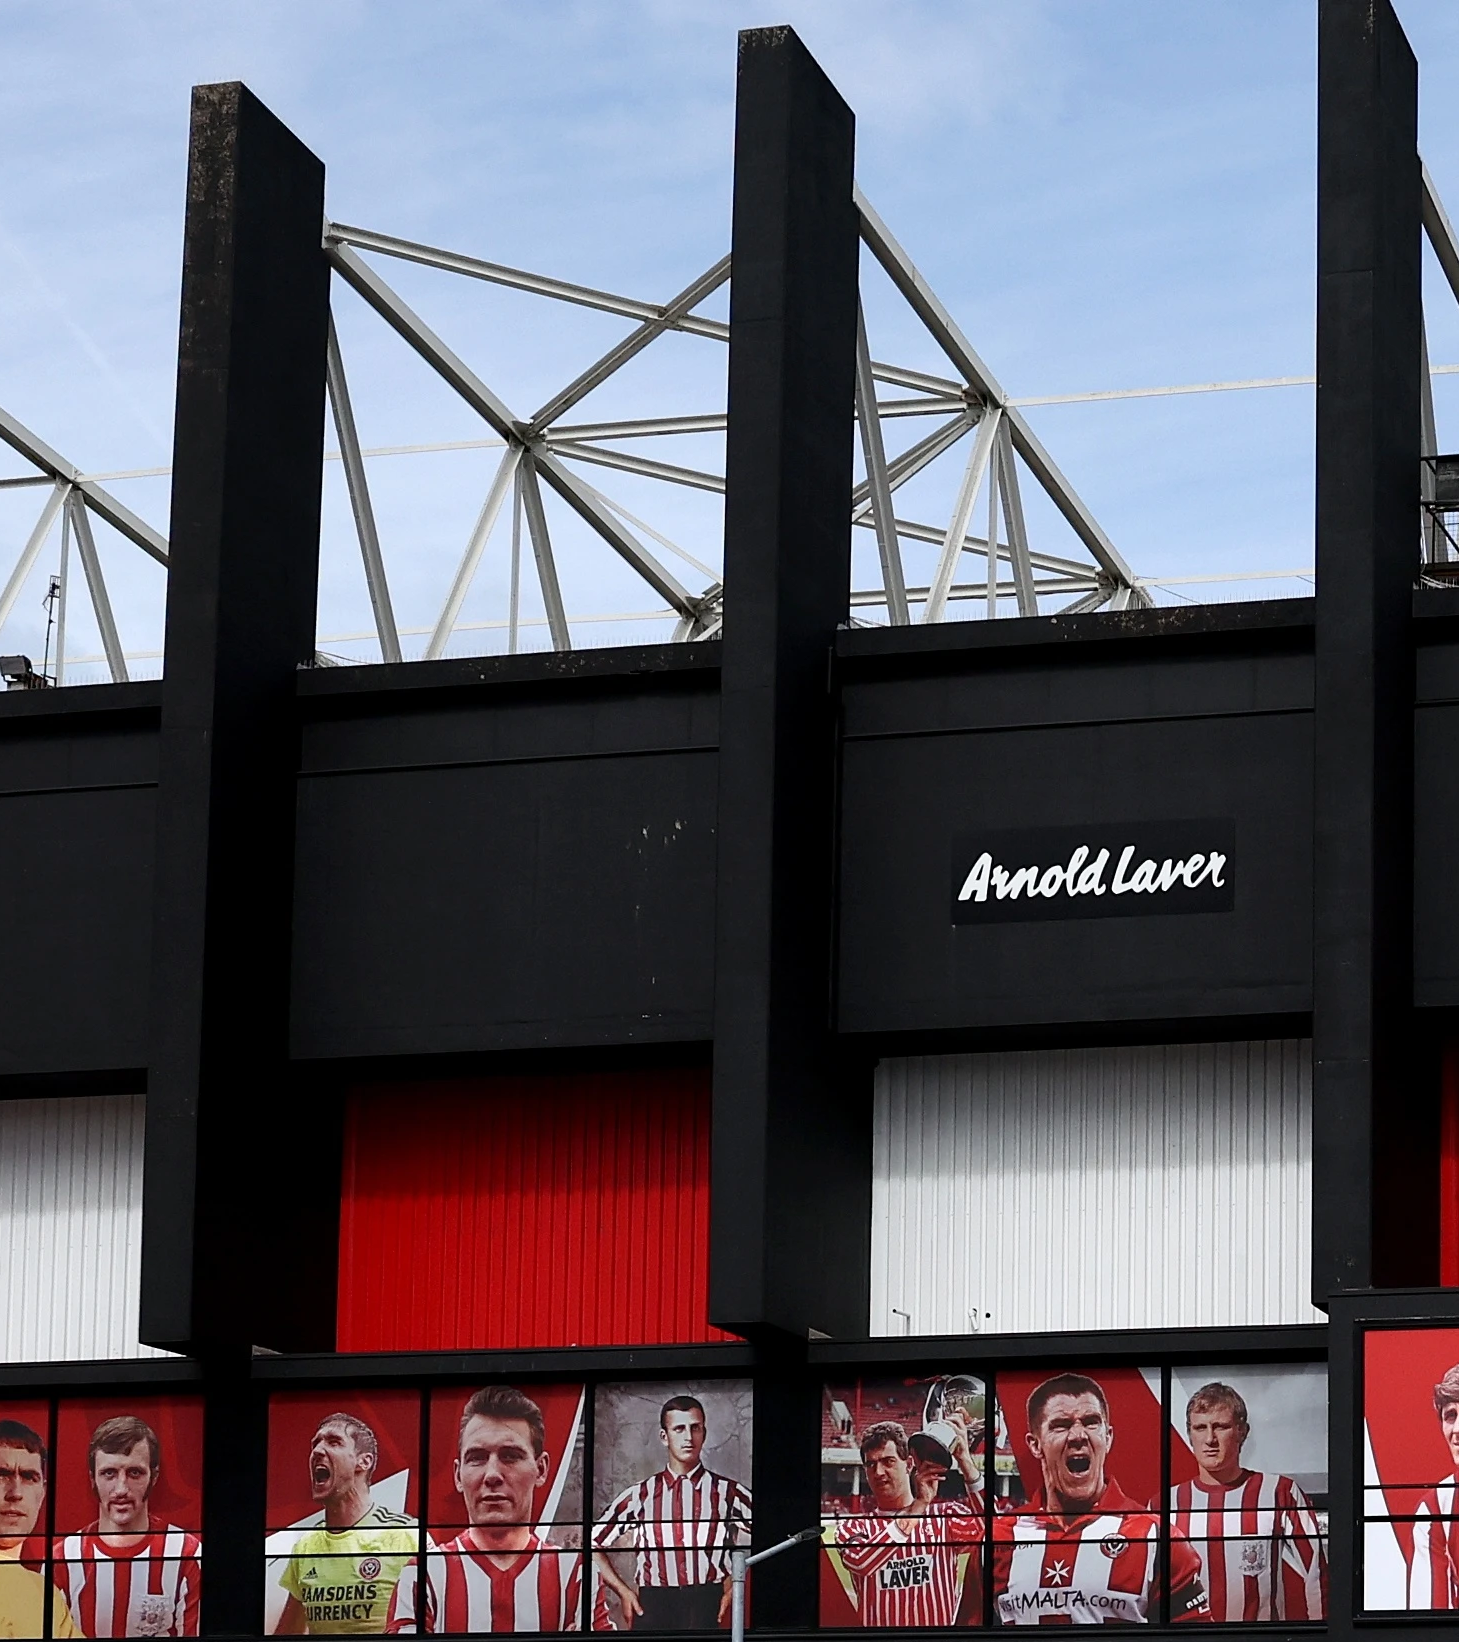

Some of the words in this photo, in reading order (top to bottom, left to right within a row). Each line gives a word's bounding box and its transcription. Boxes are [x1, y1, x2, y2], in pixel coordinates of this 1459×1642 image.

[957, 844, 1110, 902] Arnold
[1111, 845, 1227, 895] Laver
[886, 1556, 926, 1570] ARNOLD
[879, 1565, 930, 1588] LAVER
[302, 1584, 377, 1602] RAMSDENS
[307, 1604, 373, 1621] URRENCY
